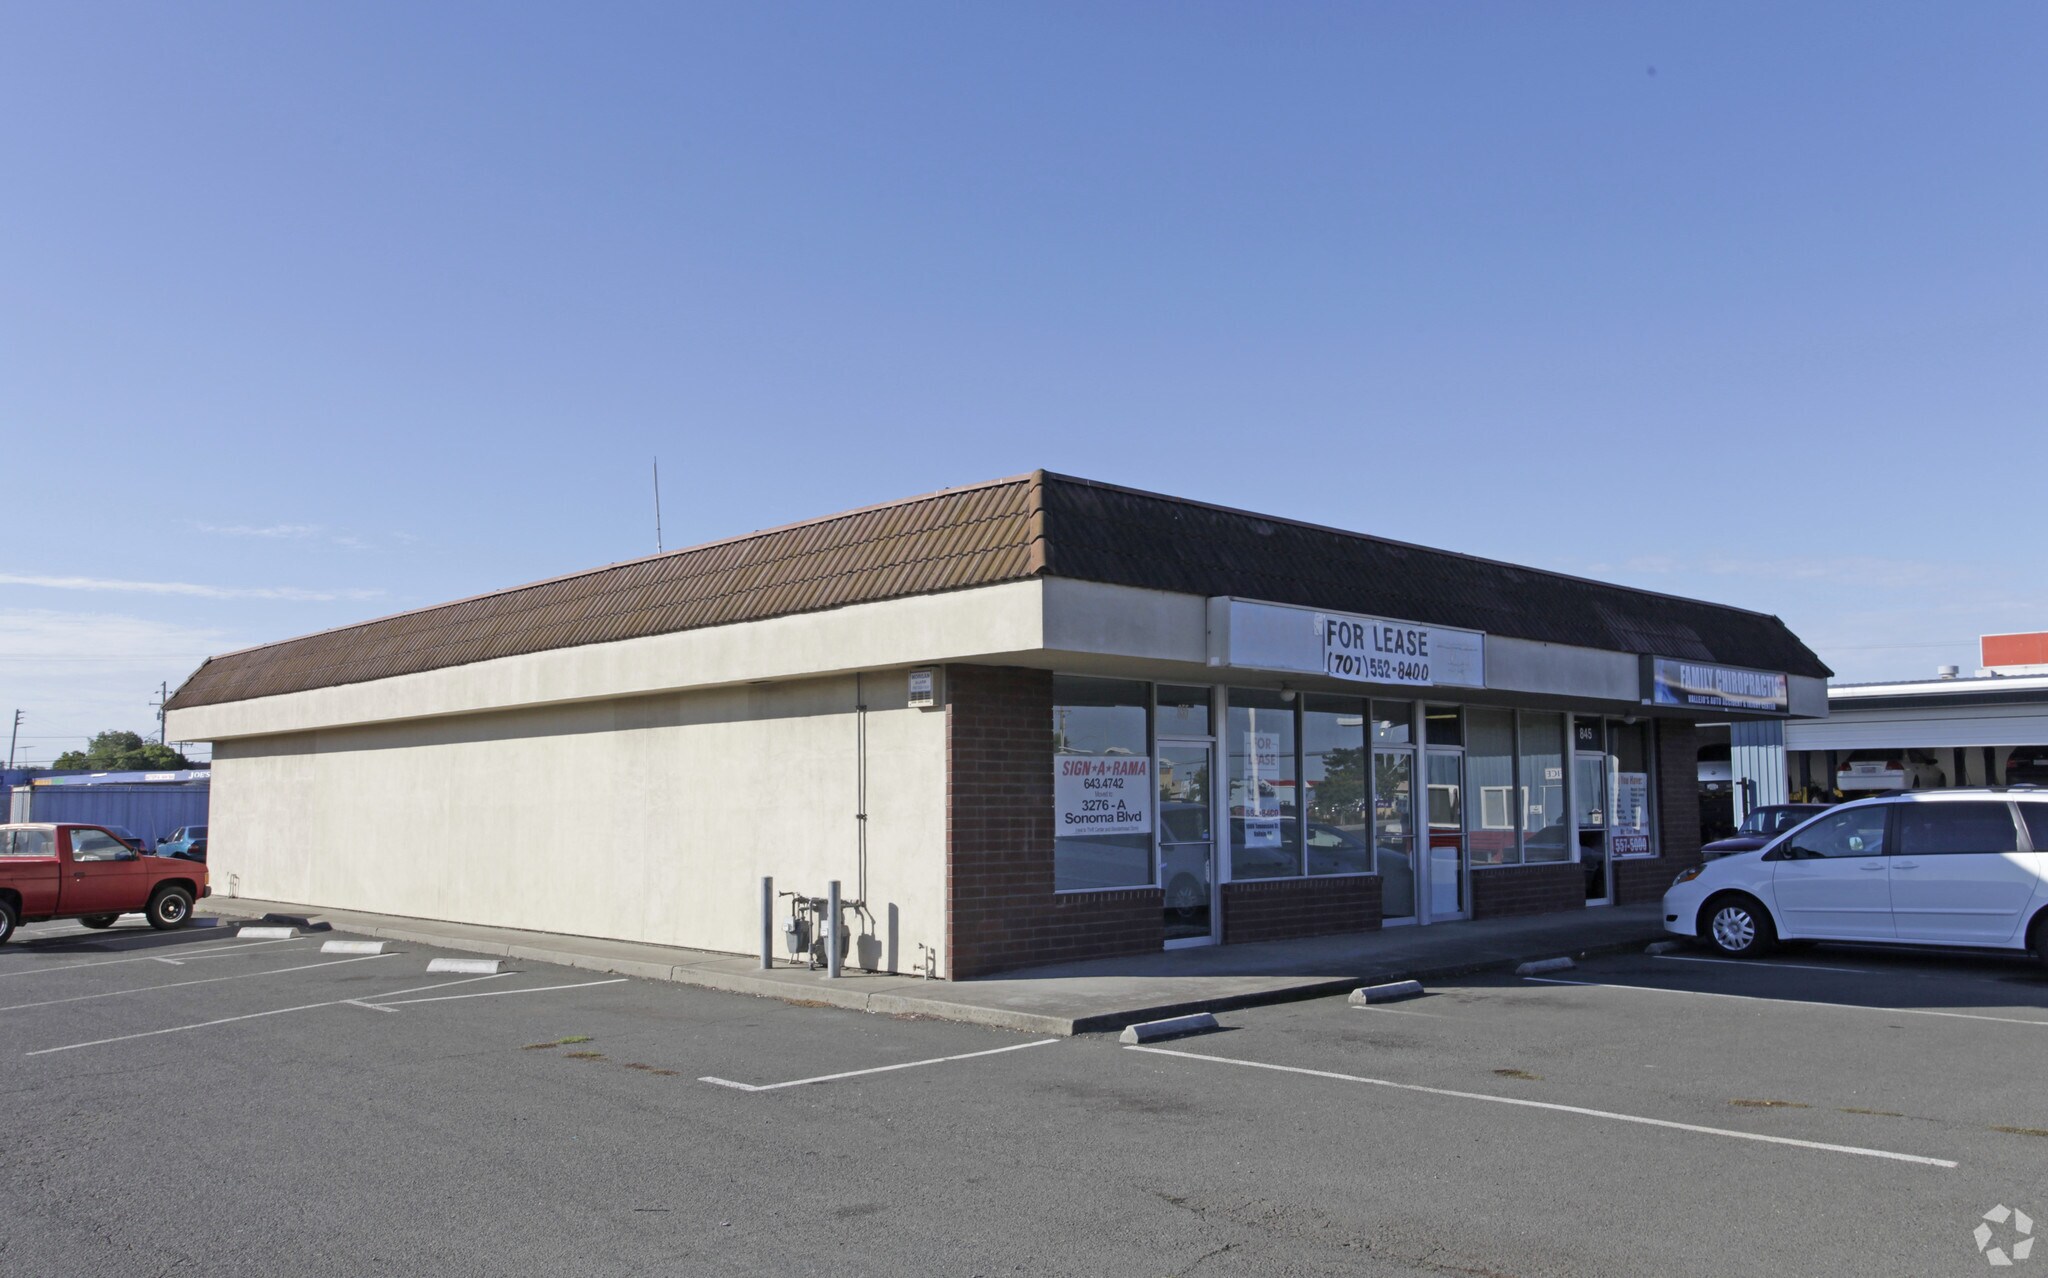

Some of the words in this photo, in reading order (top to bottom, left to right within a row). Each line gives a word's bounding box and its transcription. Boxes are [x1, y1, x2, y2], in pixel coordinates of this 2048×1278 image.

[1326, 619, 1364, 650] FOR
[1373, 625, 1428, 657] LEASE
[1680, 665, 1713, 691] FAMILY
[1715, 669, 1780, 698] CHIROPRACTIC
[1580, 728, 1592, 739] 845
[1084, 778, 1124, 789] 643.4742
[1082, 799, 1109, 811] 3276
[1065, 812, 1114, 824] Sonoma
[1116, 811, 1142, 822] Blvd
